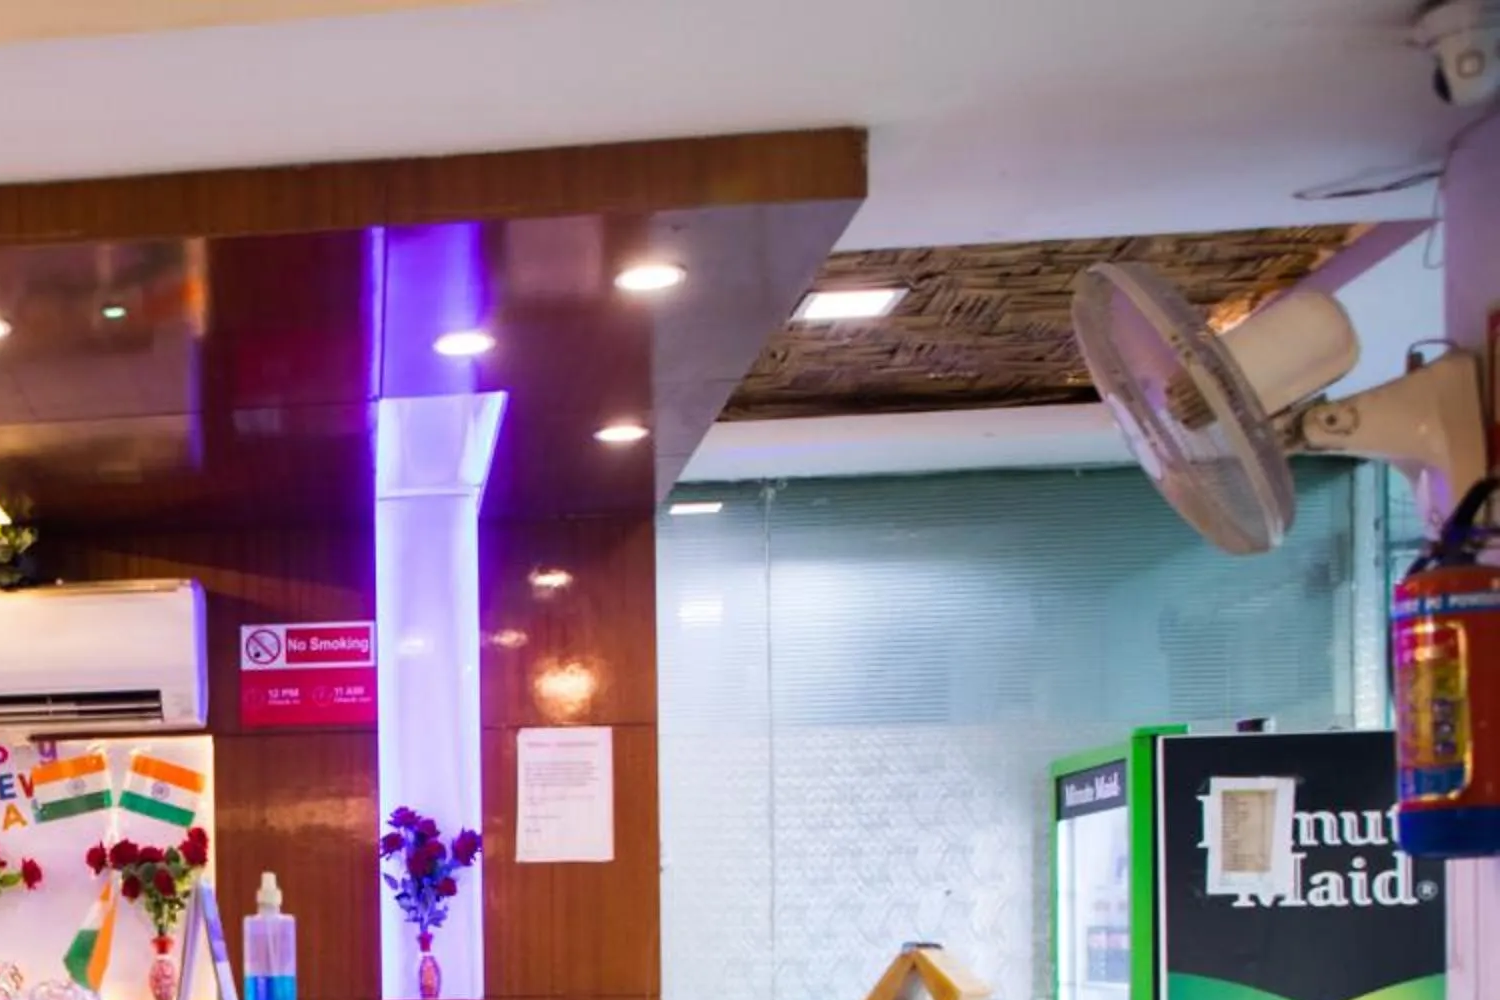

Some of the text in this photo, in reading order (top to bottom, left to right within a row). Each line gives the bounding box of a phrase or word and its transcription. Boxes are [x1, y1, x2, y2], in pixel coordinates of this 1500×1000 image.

[287, 637, 369, 653] No Smoking
[1095, 771, 1120, 800] Maid
